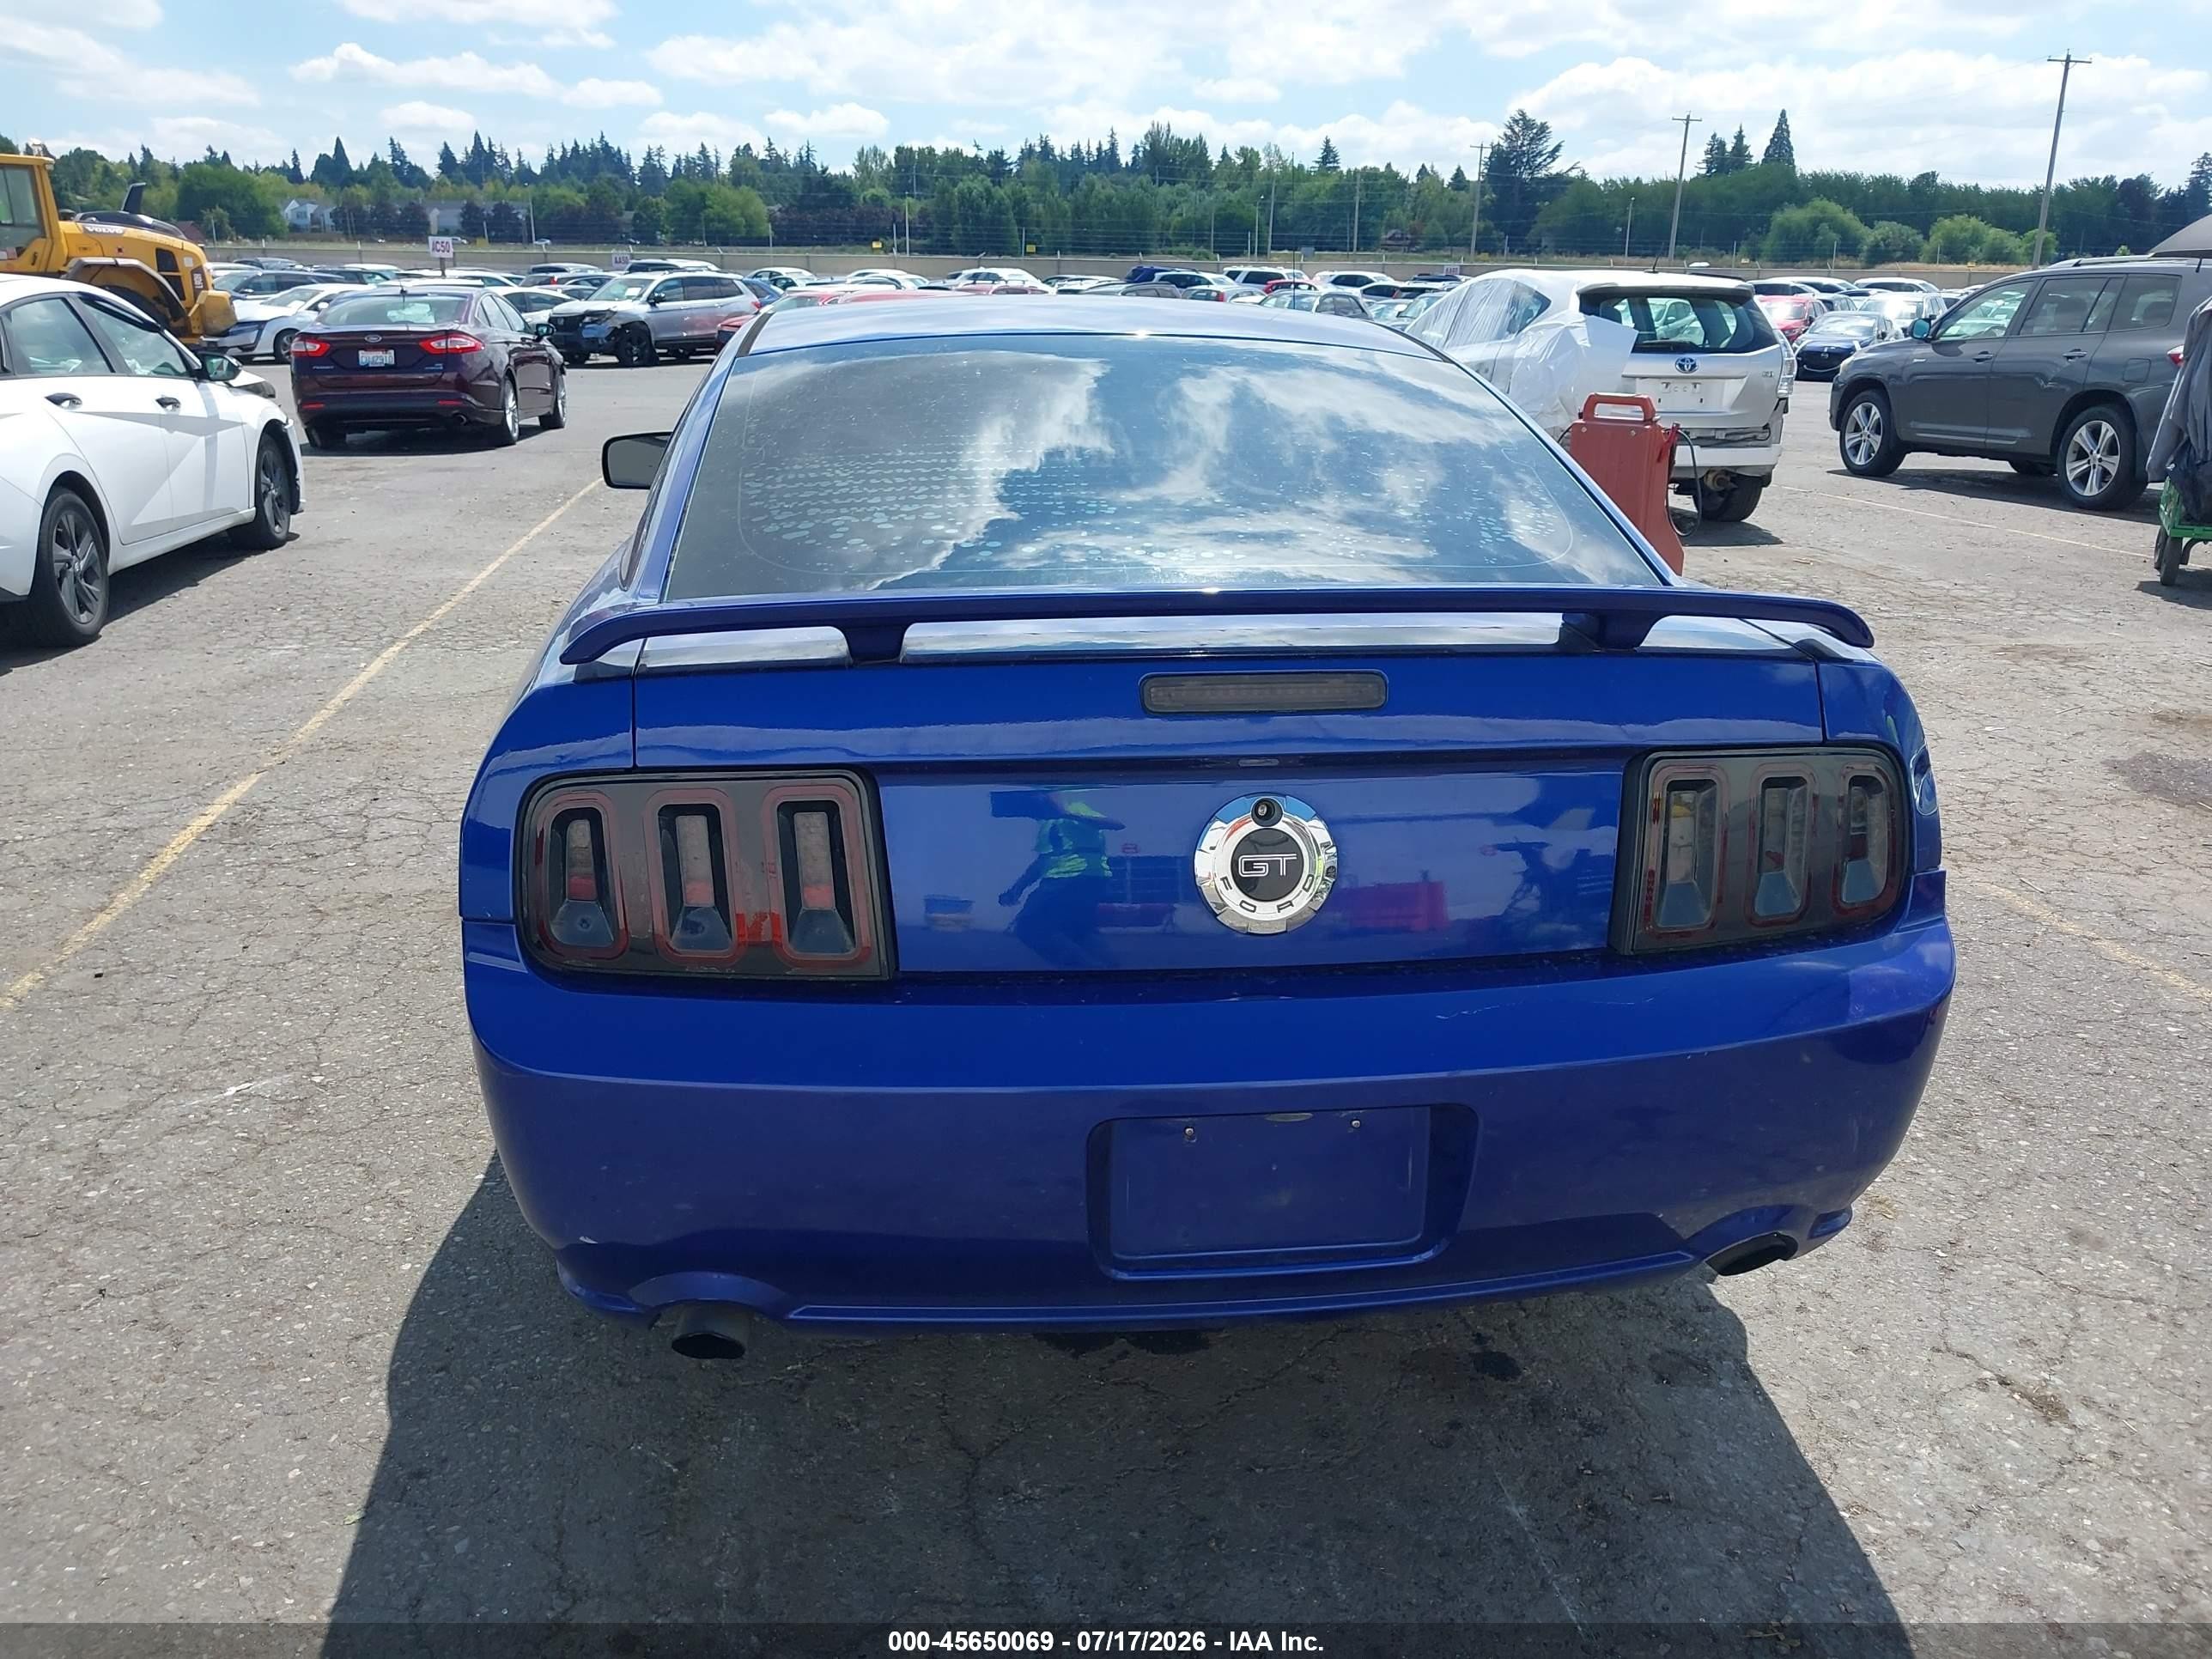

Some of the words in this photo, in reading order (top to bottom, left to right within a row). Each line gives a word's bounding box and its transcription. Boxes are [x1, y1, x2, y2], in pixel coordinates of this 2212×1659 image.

[85, 225, 124, 234] VOLVO
[1238, 853, 1297, 878] GT
[1219, 873, 1316, 914] FORD
